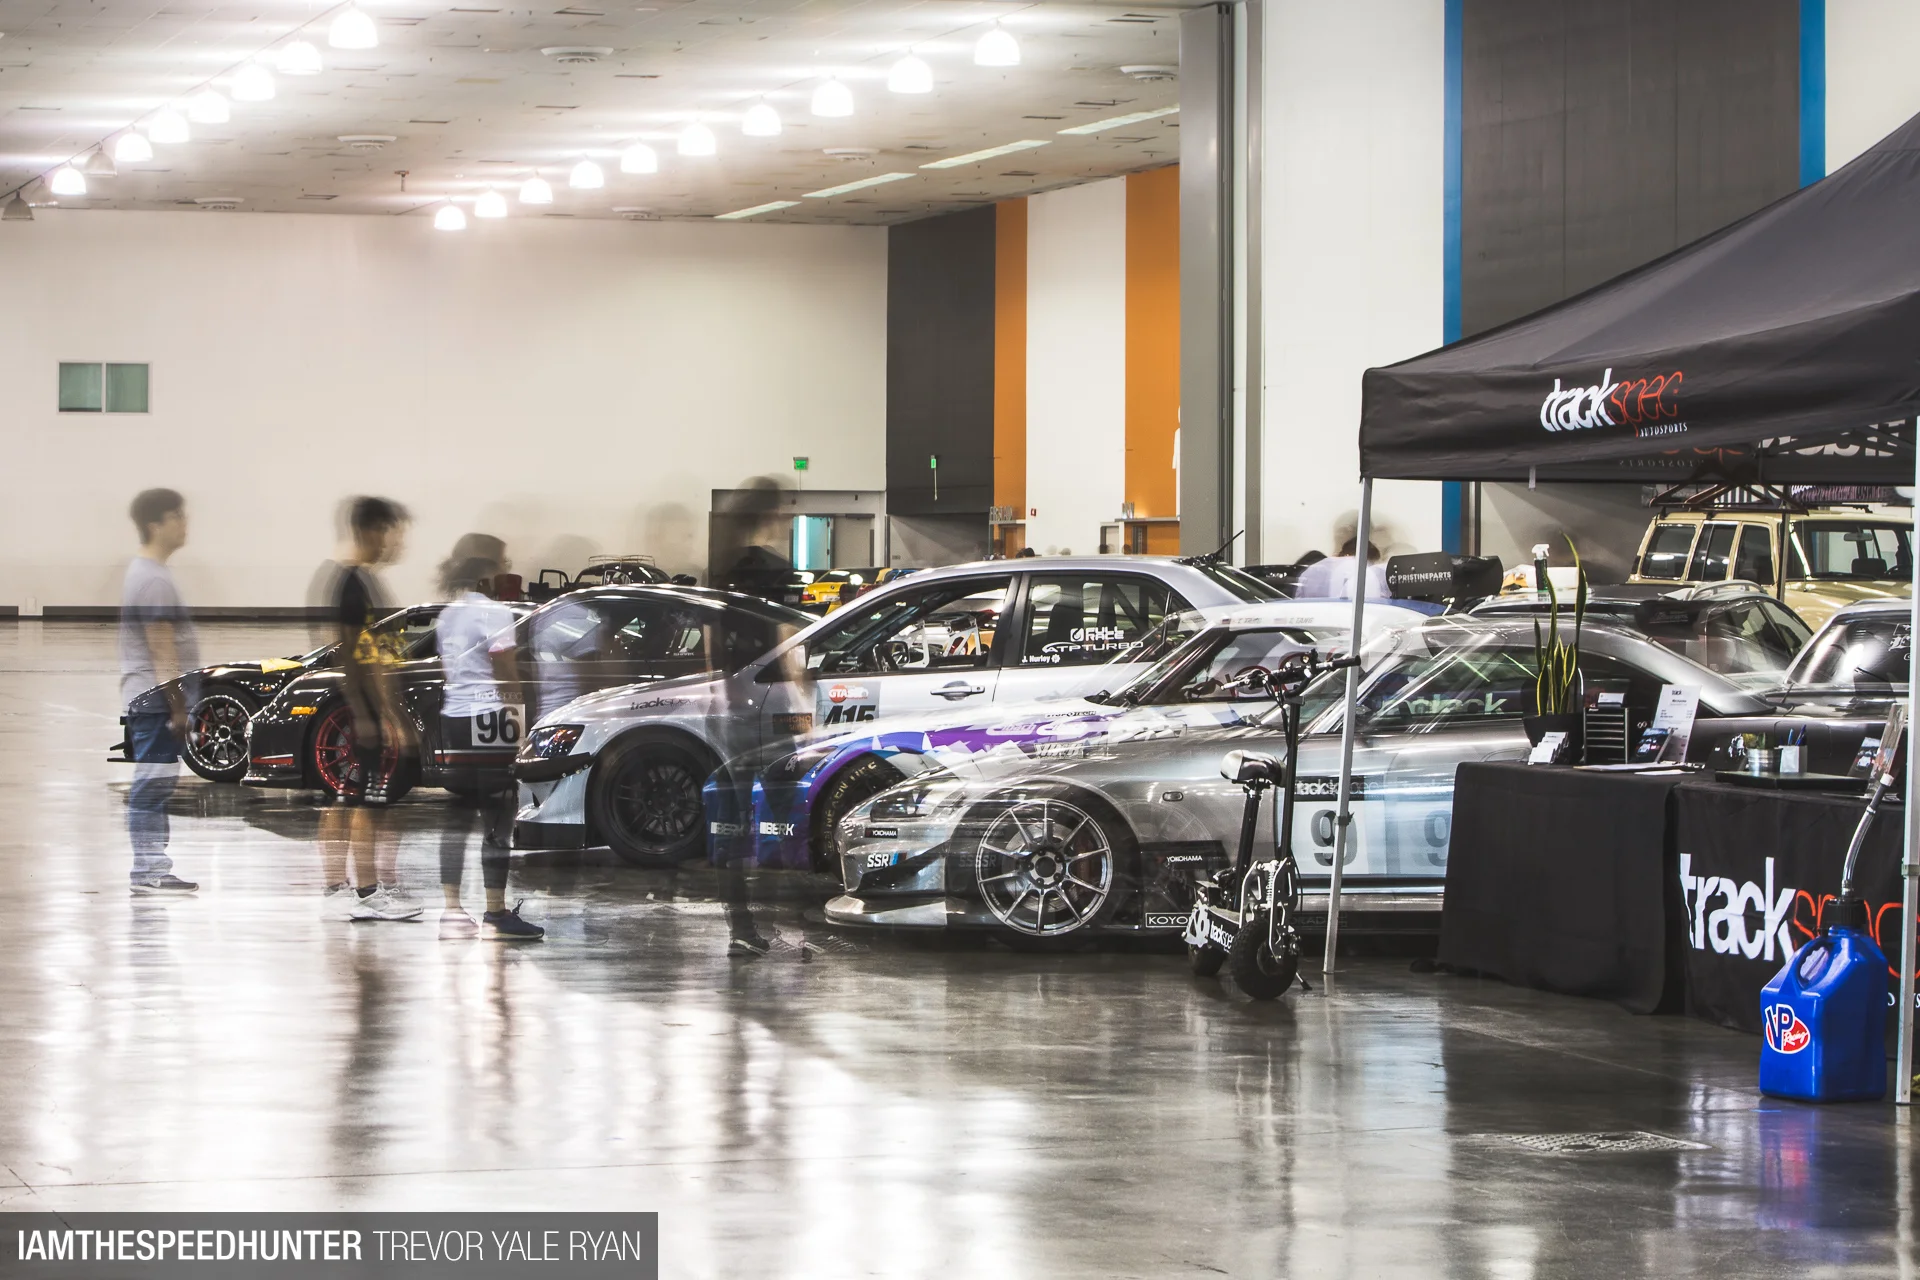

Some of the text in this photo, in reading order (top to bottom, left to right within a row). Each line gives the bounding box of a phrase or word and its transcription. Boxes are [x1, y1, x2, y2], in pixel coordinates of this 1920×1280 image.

[1639, 422, 1688, 437] AUTOSPORTS
[475, 706, 521, 744] 96
[867, 854, 890, 868] SSR
[1166, 855, 1203, 863] YOKOHAMA
[1765, 1004, 1795, 1051] VP
